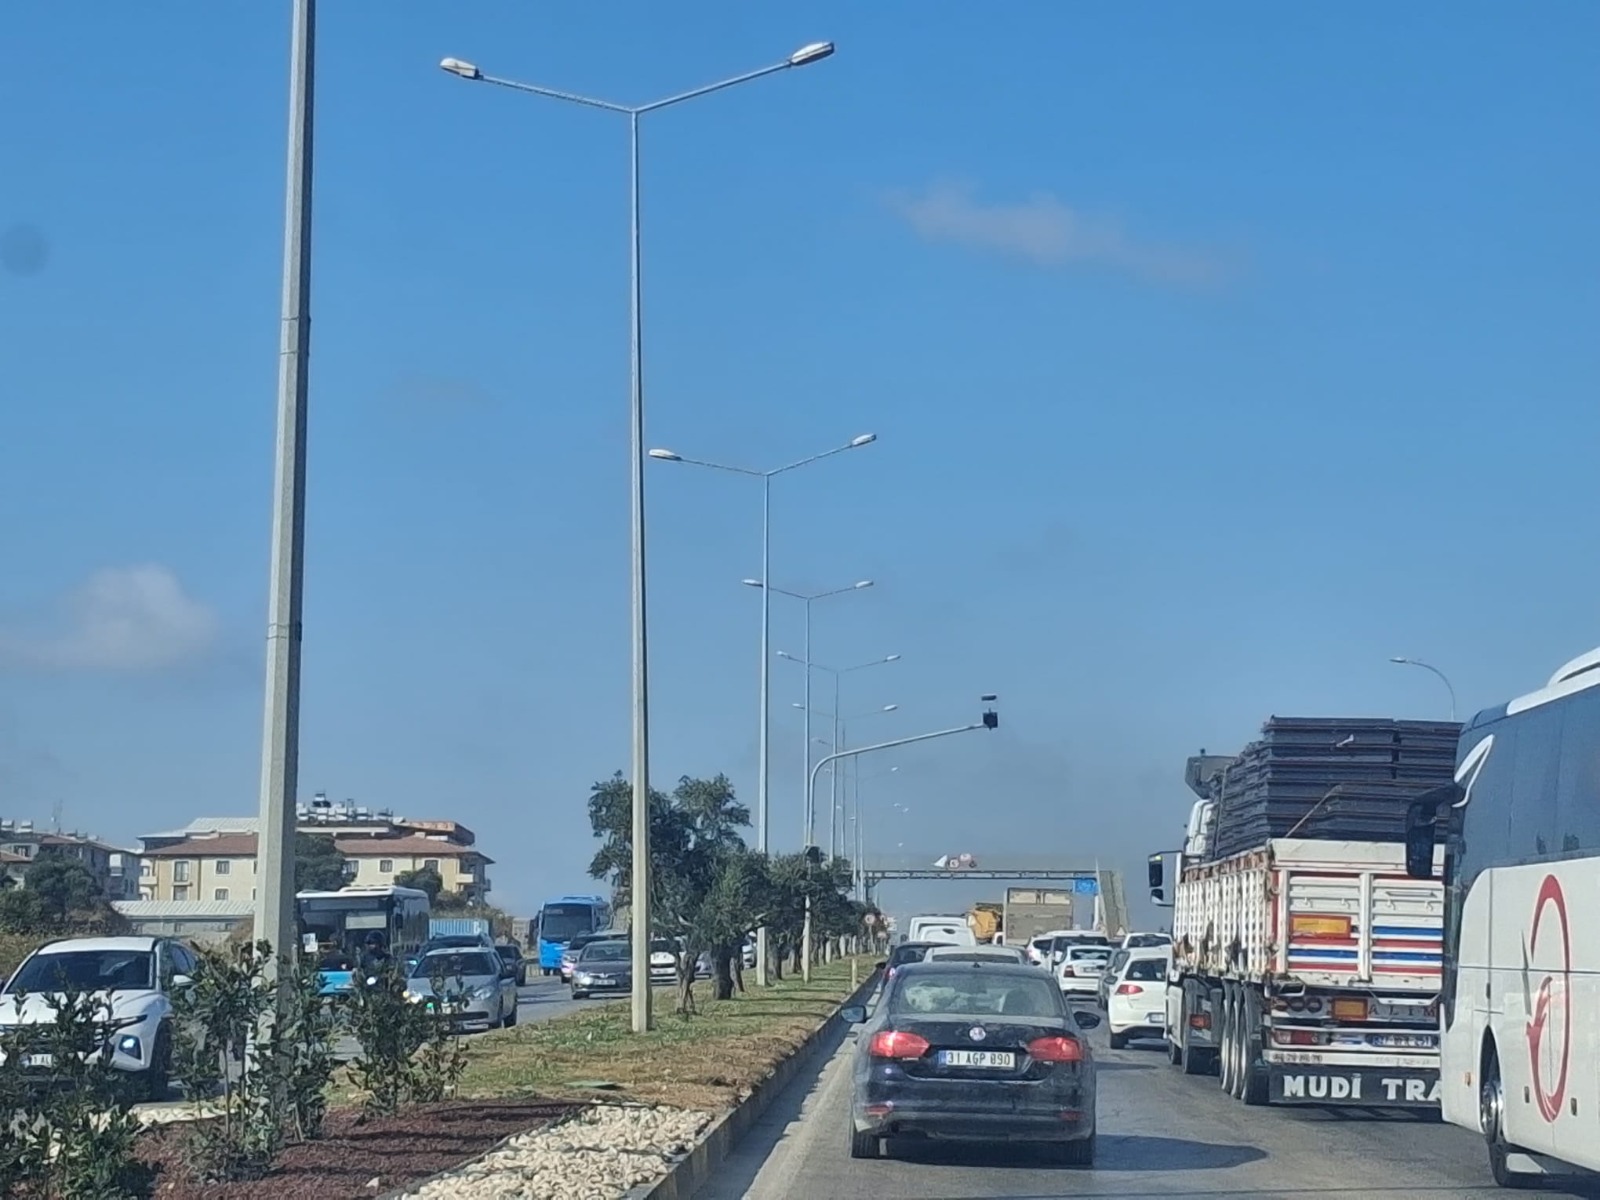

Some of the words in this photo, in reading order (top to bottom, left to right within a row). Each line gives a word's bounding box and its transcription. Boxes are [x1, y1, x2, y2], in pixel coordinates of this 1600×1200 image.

[947, 1051, 961, 1064] 31
[965, 1052, 986, 1065] AGP
[1283, 1073, 1362, 1099] MUDİ
